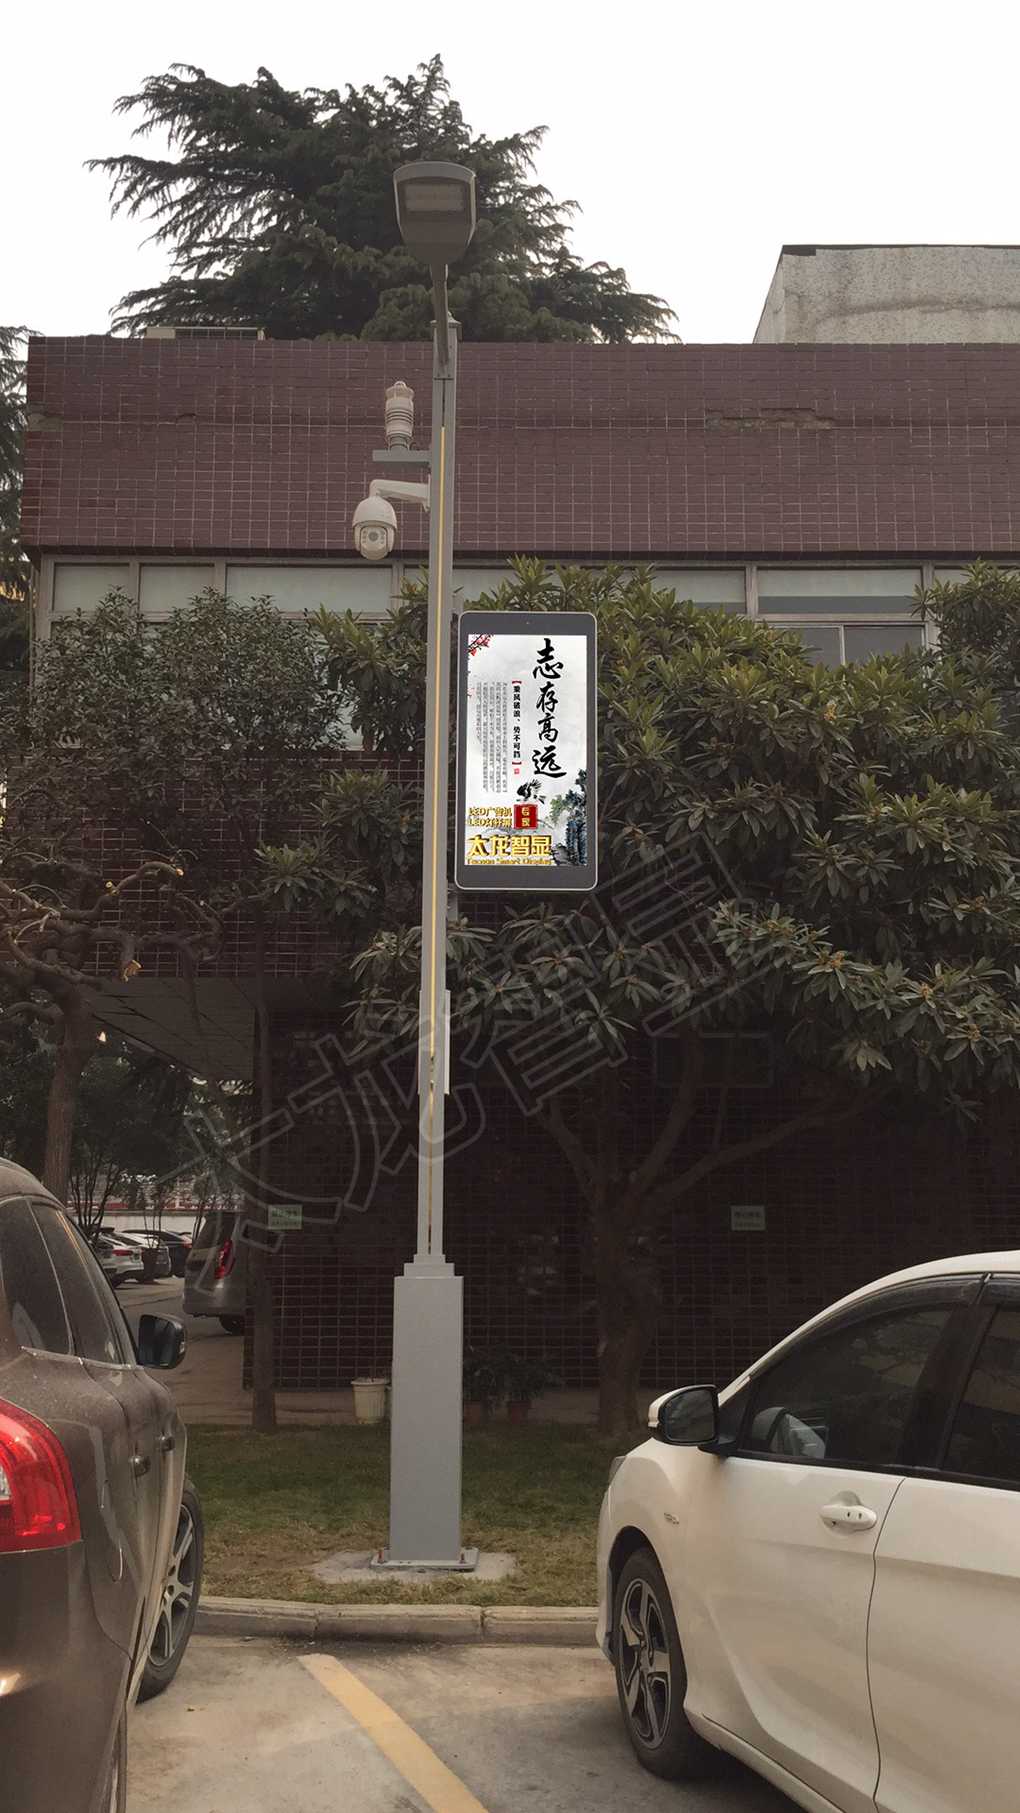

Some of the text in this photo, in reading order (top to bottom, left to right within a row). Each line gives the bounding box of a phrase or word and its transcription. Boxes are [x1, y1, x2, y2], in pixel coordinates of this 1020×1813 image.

[532, 638, 567, 778] 志存高远
[468, 834, 552, 857] 太龙智显
